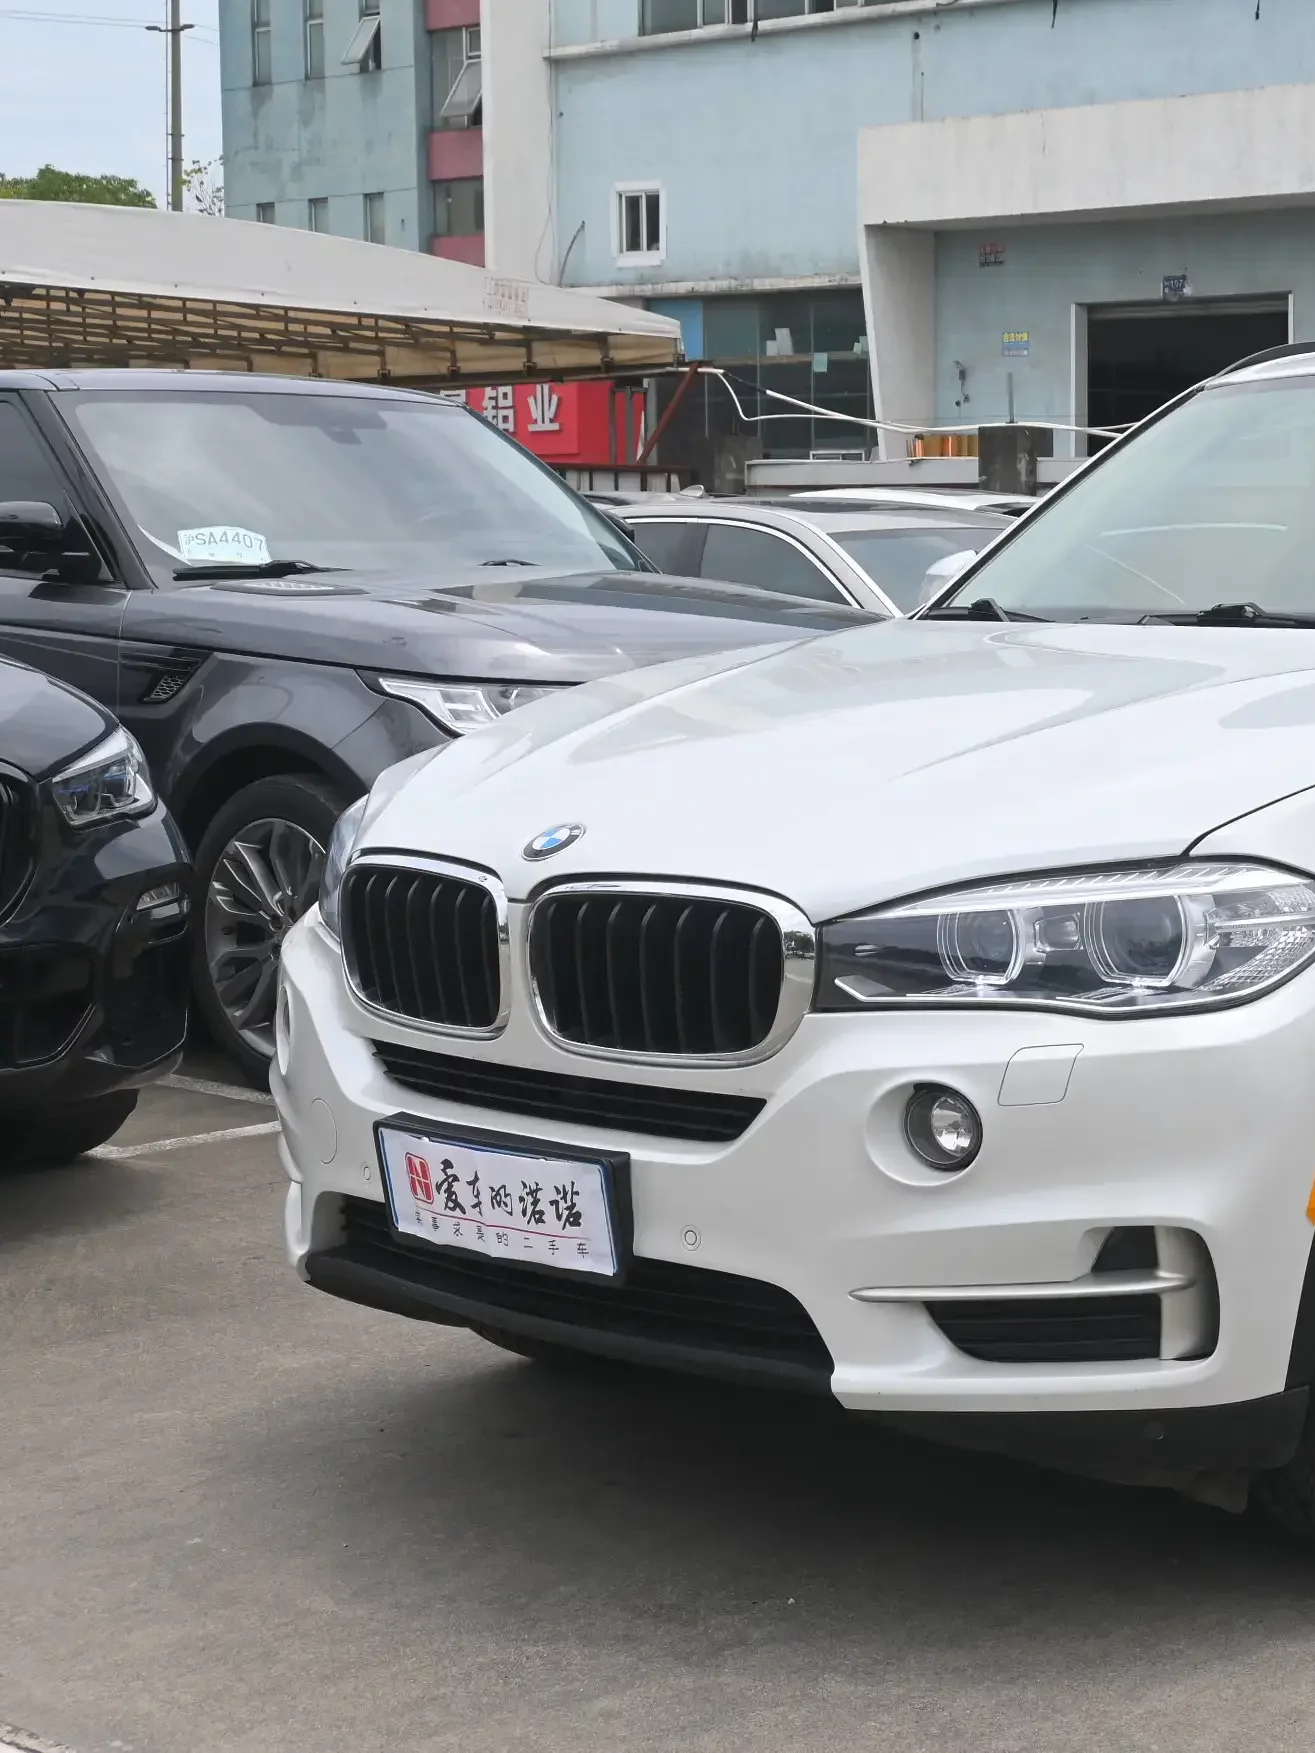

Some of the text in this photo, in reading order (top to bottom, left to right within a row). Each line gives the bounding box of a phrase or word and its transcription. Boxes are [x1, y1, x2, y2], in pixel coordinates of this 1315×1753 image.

[439, 384, 561, 433] 铝业
[435, 1158, 583, 1231] 爱车的诺诺
